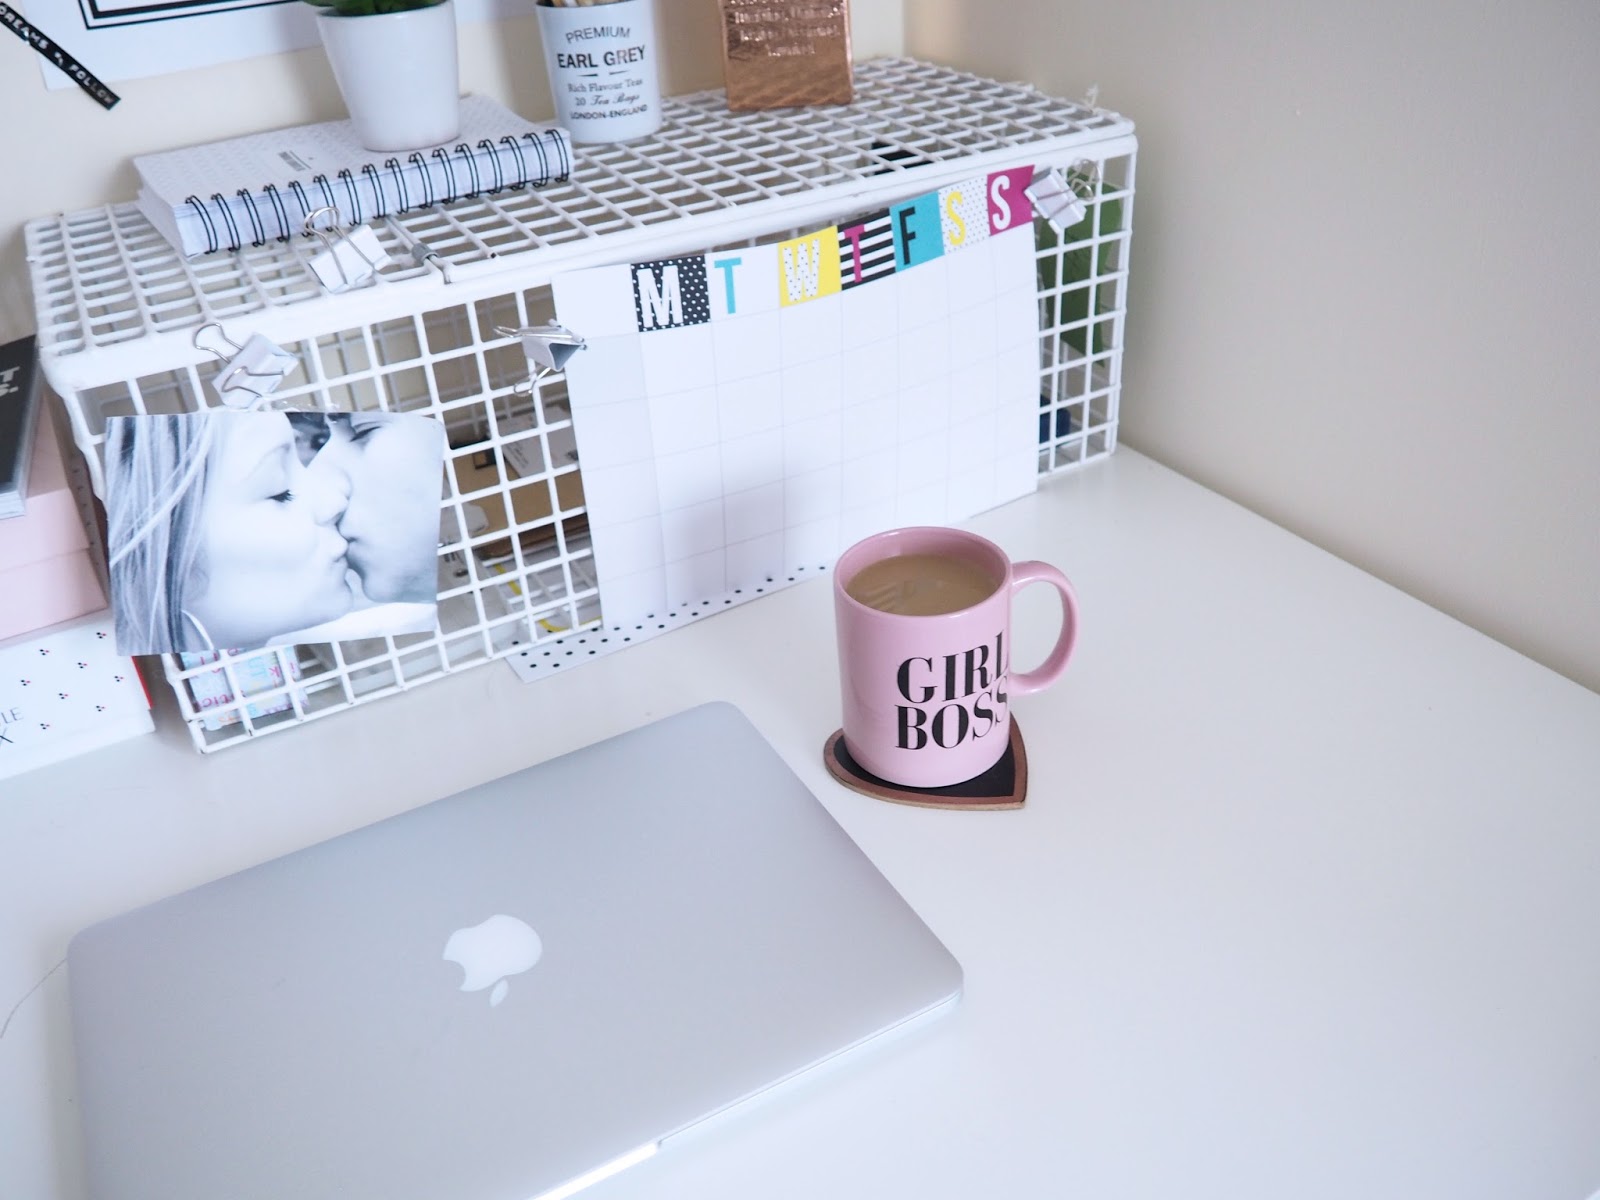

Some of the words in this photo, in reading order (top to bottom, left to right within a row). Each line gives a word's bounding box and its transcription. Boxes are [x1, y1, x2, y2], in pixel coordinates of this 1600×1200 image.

[566, 26, 630, 44] PREMIUM
[557, 53, 598, 68] EARL
[603, 44, 646, 66] GREY
[568, 83, 587, 92] Rich
[588, 81, 623, 92] Flavour
[590, 95, 610, 106] Tea
[636, 264, 685, 329] M
[713, 257, 743, 315] T
[782, 238, 821, 303] W
[844, 224, 866, 284] T
[897, 206, 917, 266] F
[945, 190, 967, 247] S
[990, 174, 1012, 231] S
[896, 629, 1008, 704] GIRL
[894, 675, 1009, 751] BOSS
